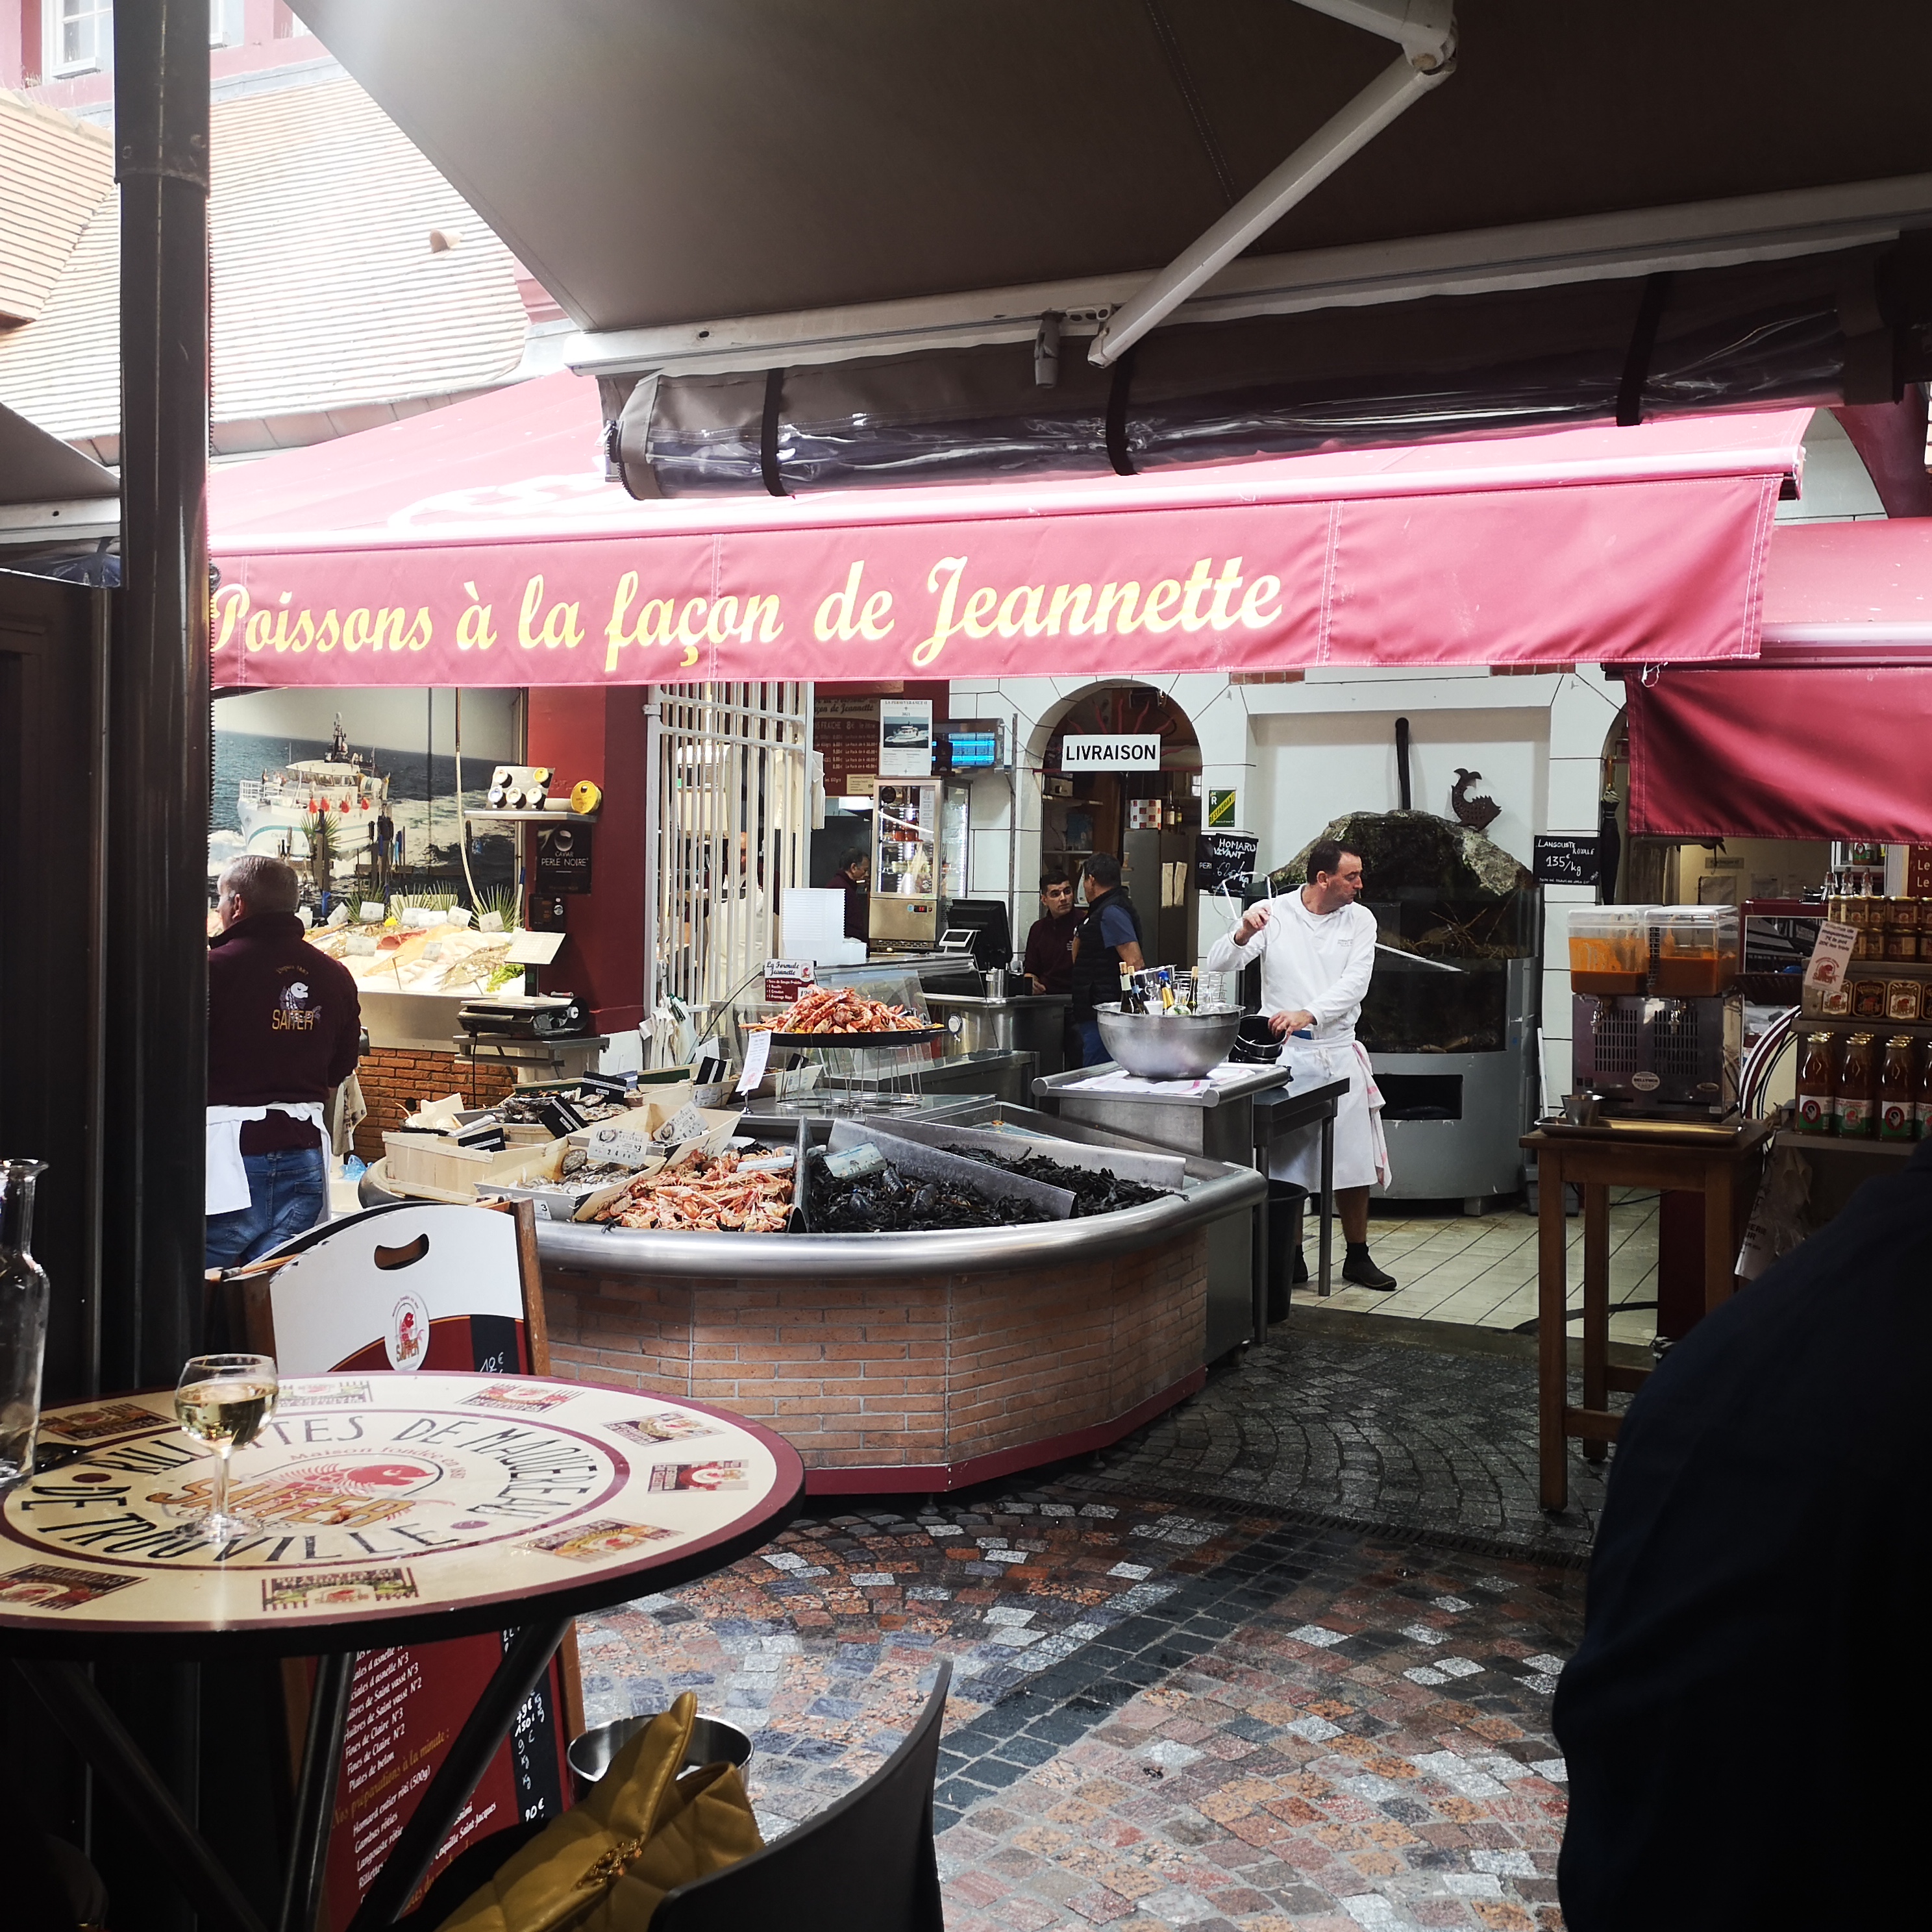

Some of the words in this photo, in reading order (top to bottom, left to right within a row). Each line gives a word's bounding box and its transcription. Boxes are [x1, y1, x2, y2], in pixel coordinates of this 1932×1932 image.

[212, 583, 432, 652] Poissons
[456, 580, 497, 650] à
[518, 574, 585, 649] la
[604, 571, 784, 672] façon
[814, 560, 895, 643] de
[912, 555, 1283, 667] Jeannette
[1066, 745, 1156, 760] LIVRAISON
[541, 858, 561, 867] PERLE
[1918, 860, 1931, 871] Le
[1916, 877, 1930, 887] Le
[272, 1009, 314, 1030] SAITER
[290, 1446, 373, 1461] Maison
[380, 1446, 443, 1460] fondée
[79, 1415, 364, 1475] RILLTES
[390, 1418, 480, 1445] DE
[454, 1428, 599, 1519] MAQUEREAU
[21, 1485, 132, 1511] DE
[37, 1512, 460, 1562] TROUVILLE
[365, 1696, 373, 1708] de
[374, 1682, 390, 1702] Saint
[367, 1713, 375, 1725] de
[376, 1700, 391, 1718] Saint
[345, 1741, 361, 1760] Fines
[362, 1735, 370, 1746] de
[371, 1720, 390, 1740] Claire
[347, 1757, 363, 1776] Fines
[364, 1751, 371, 1763] de
[372, 1736, 391, 1757] Claire
[410, 1749, 419, 1766] la
[349, 1772, 367, 1793] Plates
[368, 1764, 377, 1777] de
[377, 1752, 395, 1771] belon
[353, 1807, 378, 1837] Homard
[379, 1793, 397, 1814] entier
[398, 1781, 409, 1800] rôti
[410, 1765, 431, 1790] (500g)
[354, 1825, 380, 1854] Gambas
[380, 1812, 399, 1832] rôties
[357, 1839, 388, 1872] Langouste
